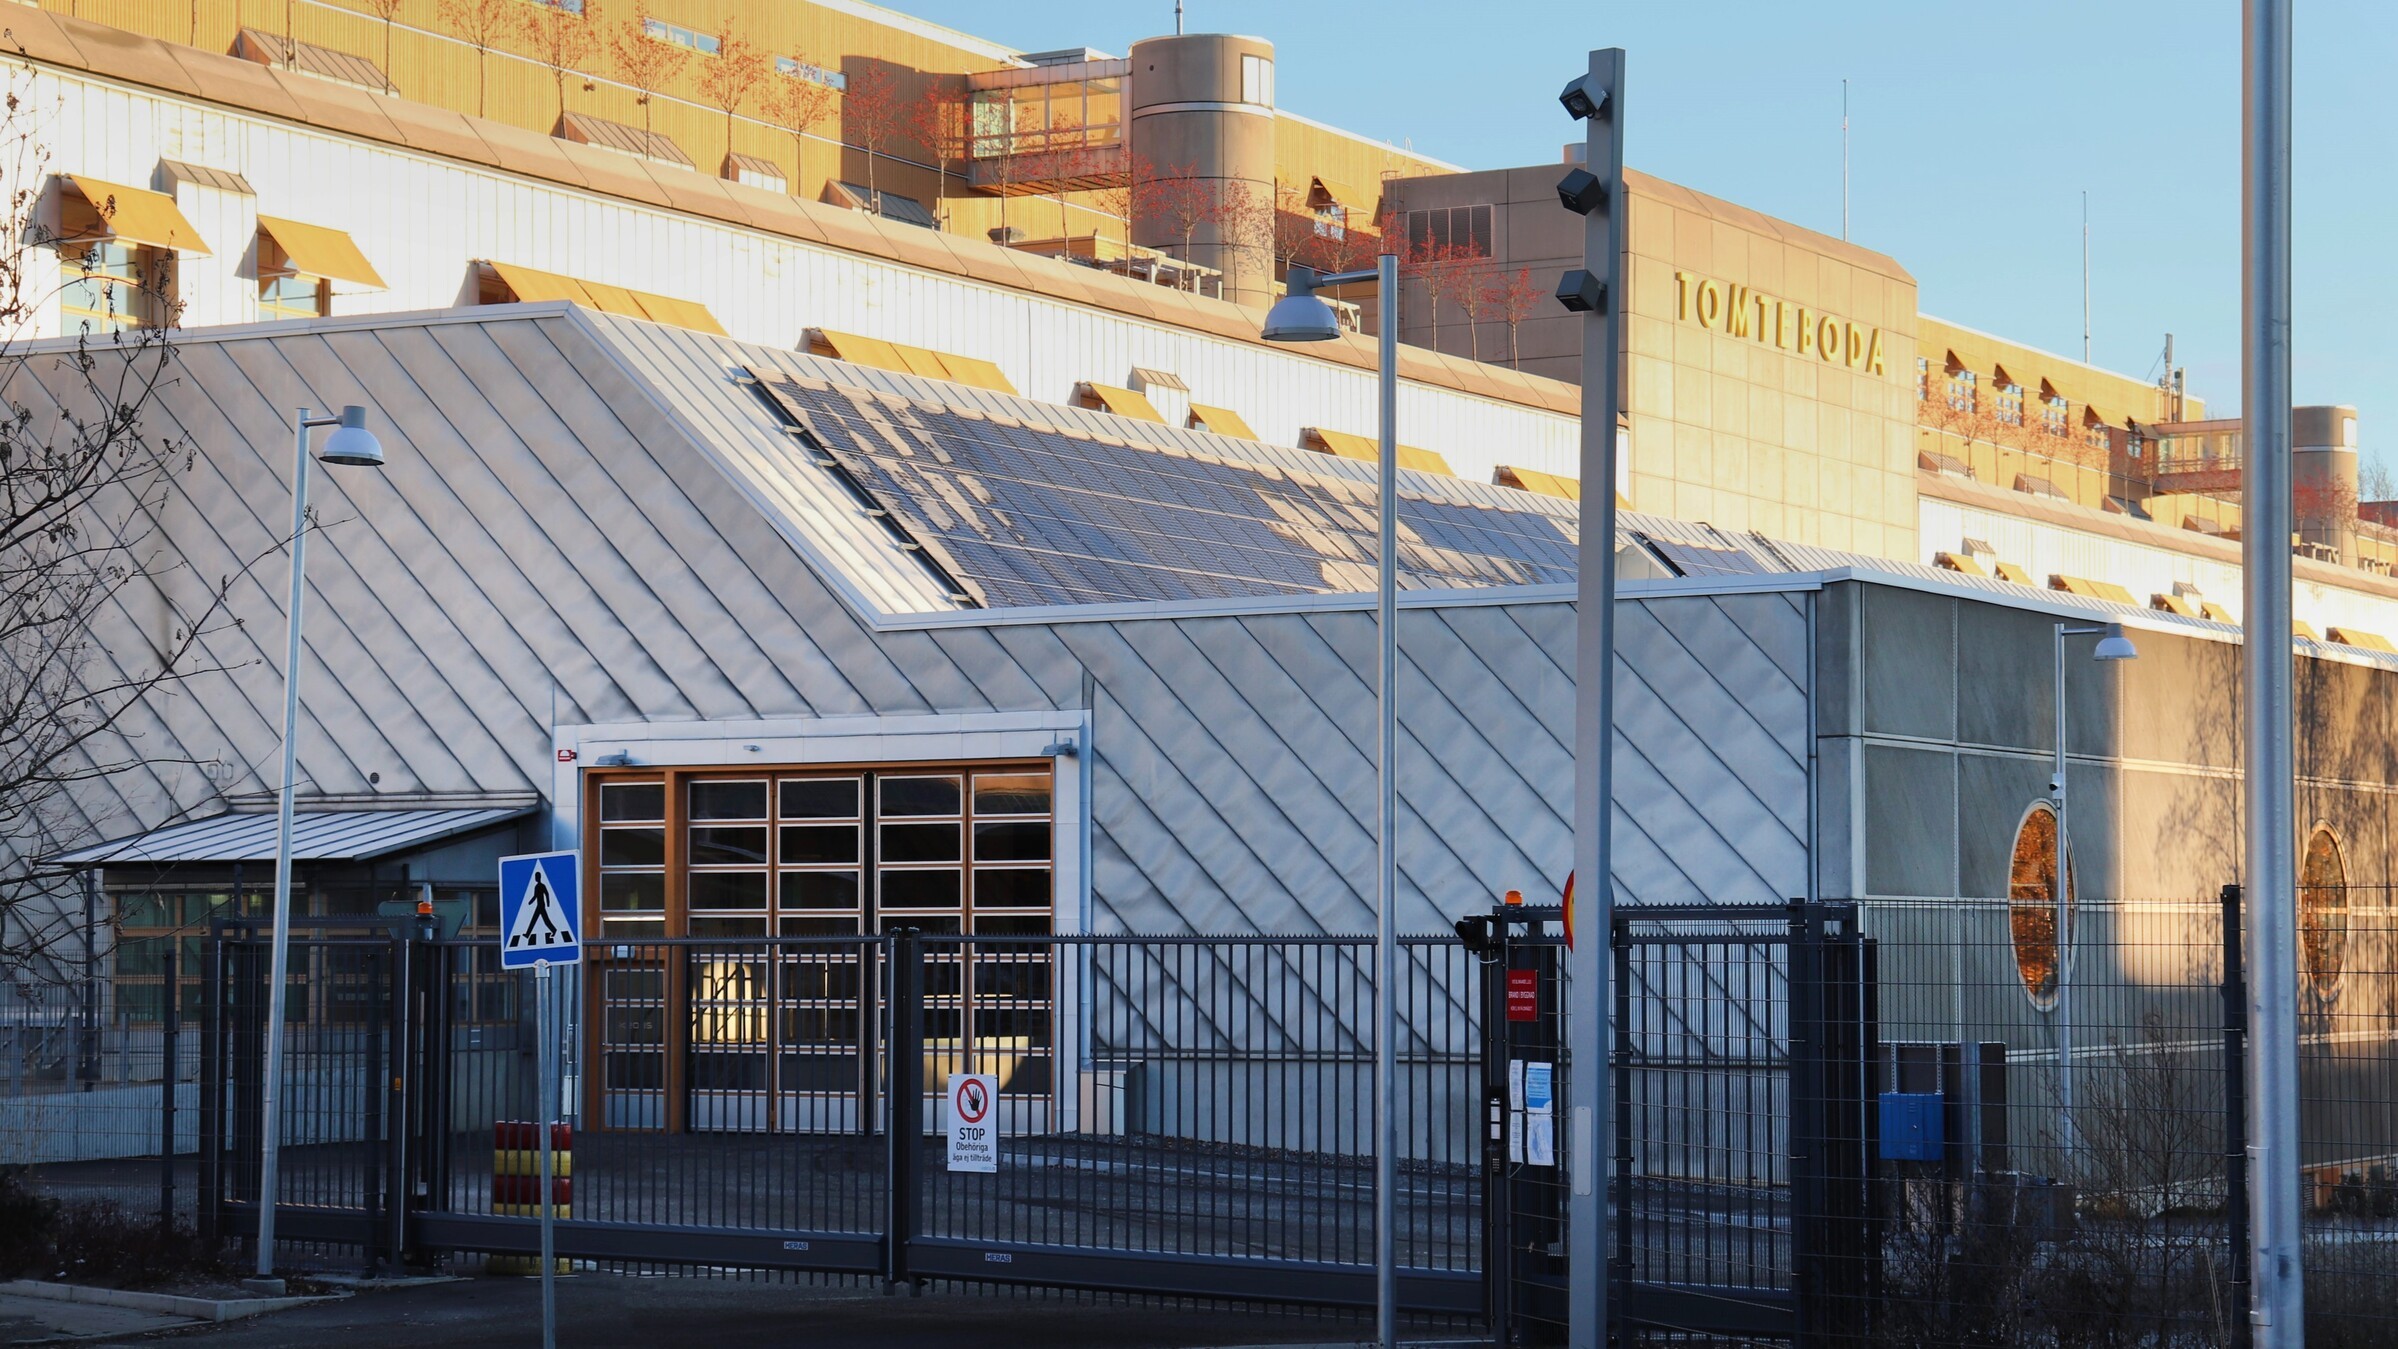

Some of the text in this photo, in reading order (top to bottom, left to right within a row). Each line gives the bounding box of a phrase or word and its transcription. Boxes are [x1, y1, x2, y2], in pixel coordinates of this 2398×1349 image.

[1675, 272, 1884, 376] TOMTEBODA
[959, 1127, 985, 1141] STOP
[956, 1141, 988, 1153] Obehöriga
[986, 1253, 1011, 1262] HERAS
